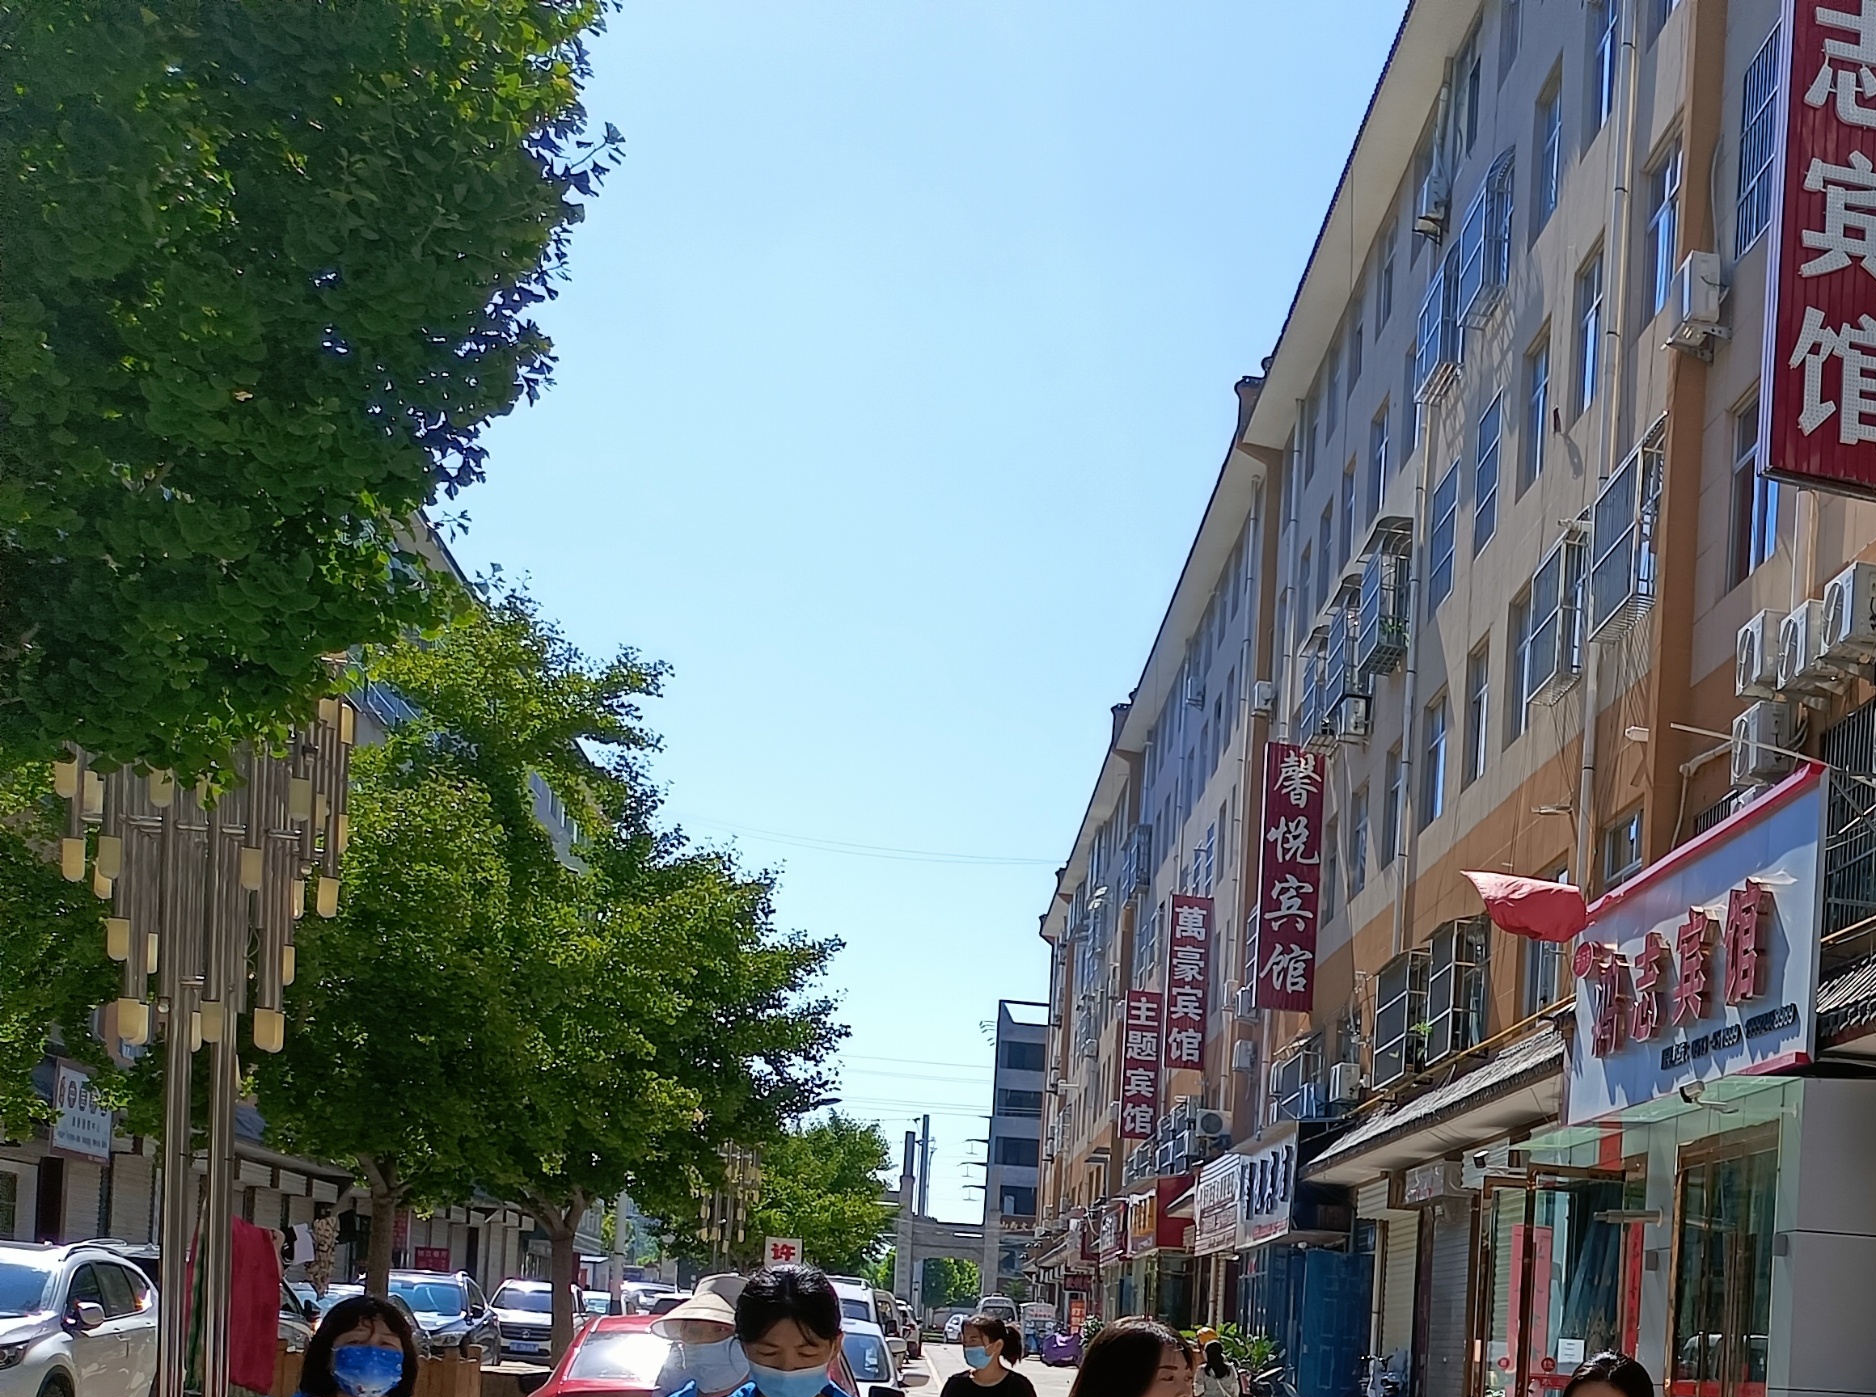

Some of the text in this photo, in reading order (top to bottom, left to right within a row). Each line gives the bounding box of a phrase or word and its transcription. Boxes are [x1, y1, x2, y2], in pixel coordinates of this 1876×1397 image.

[1259, 750, 1322, 994] 馨悦宾馆
[1168, 905, 1208, 1064] 萬豪宾馆
[1123, 996, 1159, 1136] 主题宾馆
[771, 1243, 796, 1261] 许
